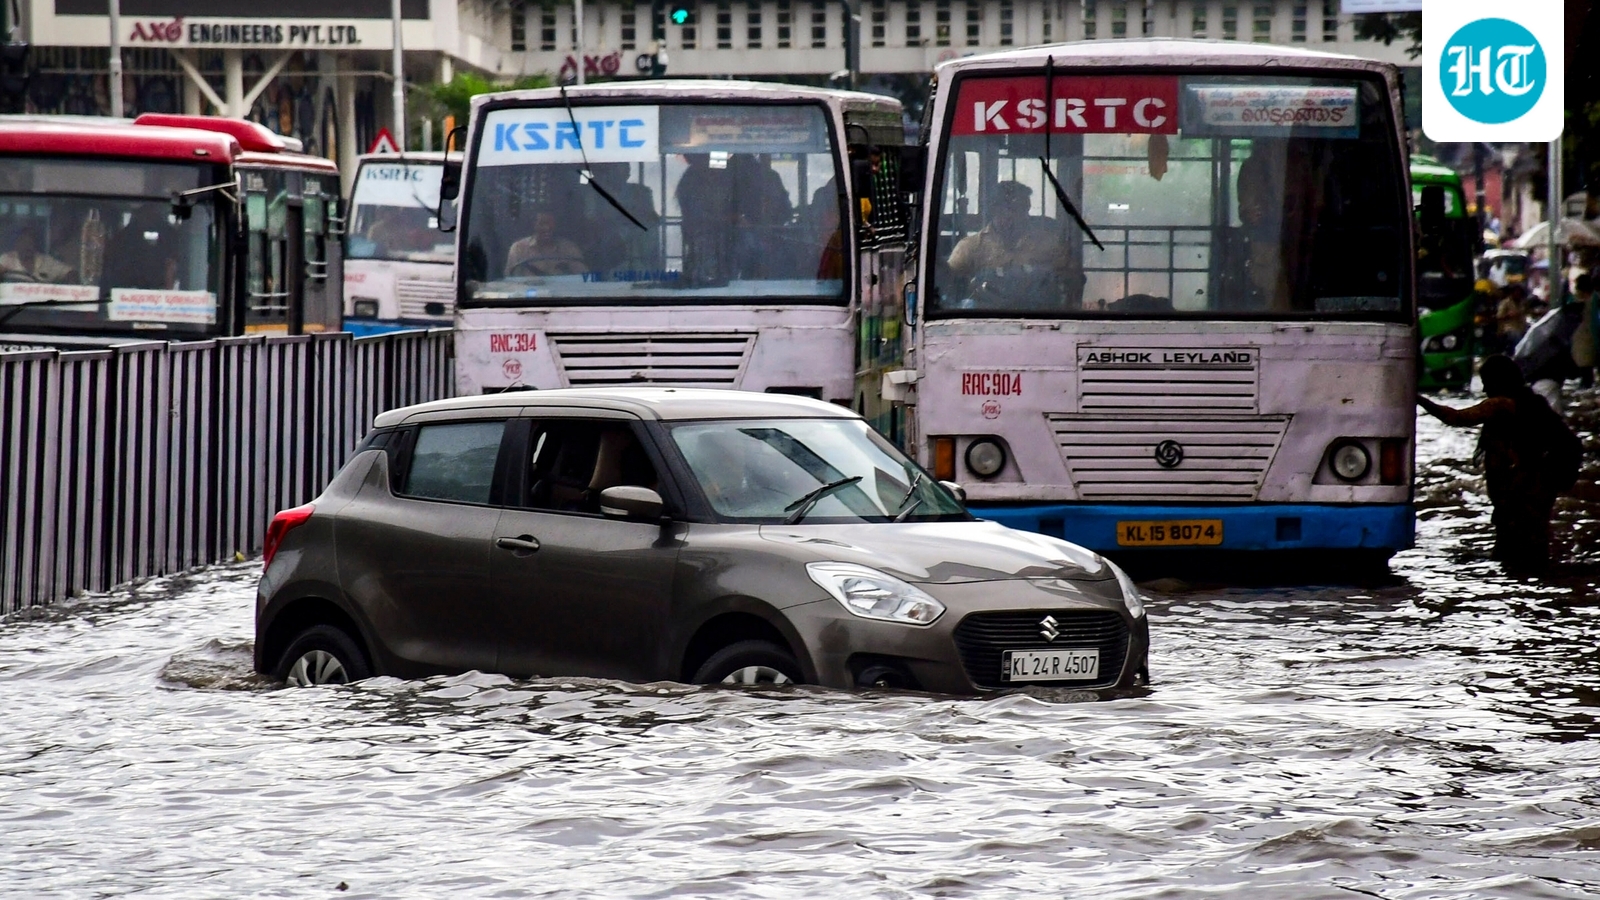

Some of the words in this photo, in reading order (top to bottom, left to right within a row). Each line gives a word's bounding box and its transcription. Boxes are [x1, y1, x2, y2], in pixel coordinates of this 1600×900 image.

[188, 24, 283, 43] ENGINEERS
[289, 25, 325, 44] PVT.
[328, 26, 361, 44] LTD.
[974, 97, 1167, 131] KSRTC
[494, 119, 646, 151] KSRTC
[366, 168, 424, 181] KSRTC
[1087, 352, 1152, 363] ASHOK
[1164, 352, 1251, 363] LEYLAND
[1170, 525, 1216, 541] 8074
[1013, 657, 1028, 676] KL
[1033, 656, 1048, 675] 24
[1052, 656, 1060, 675] R
[1065, 655, 1097, 674] 4507
